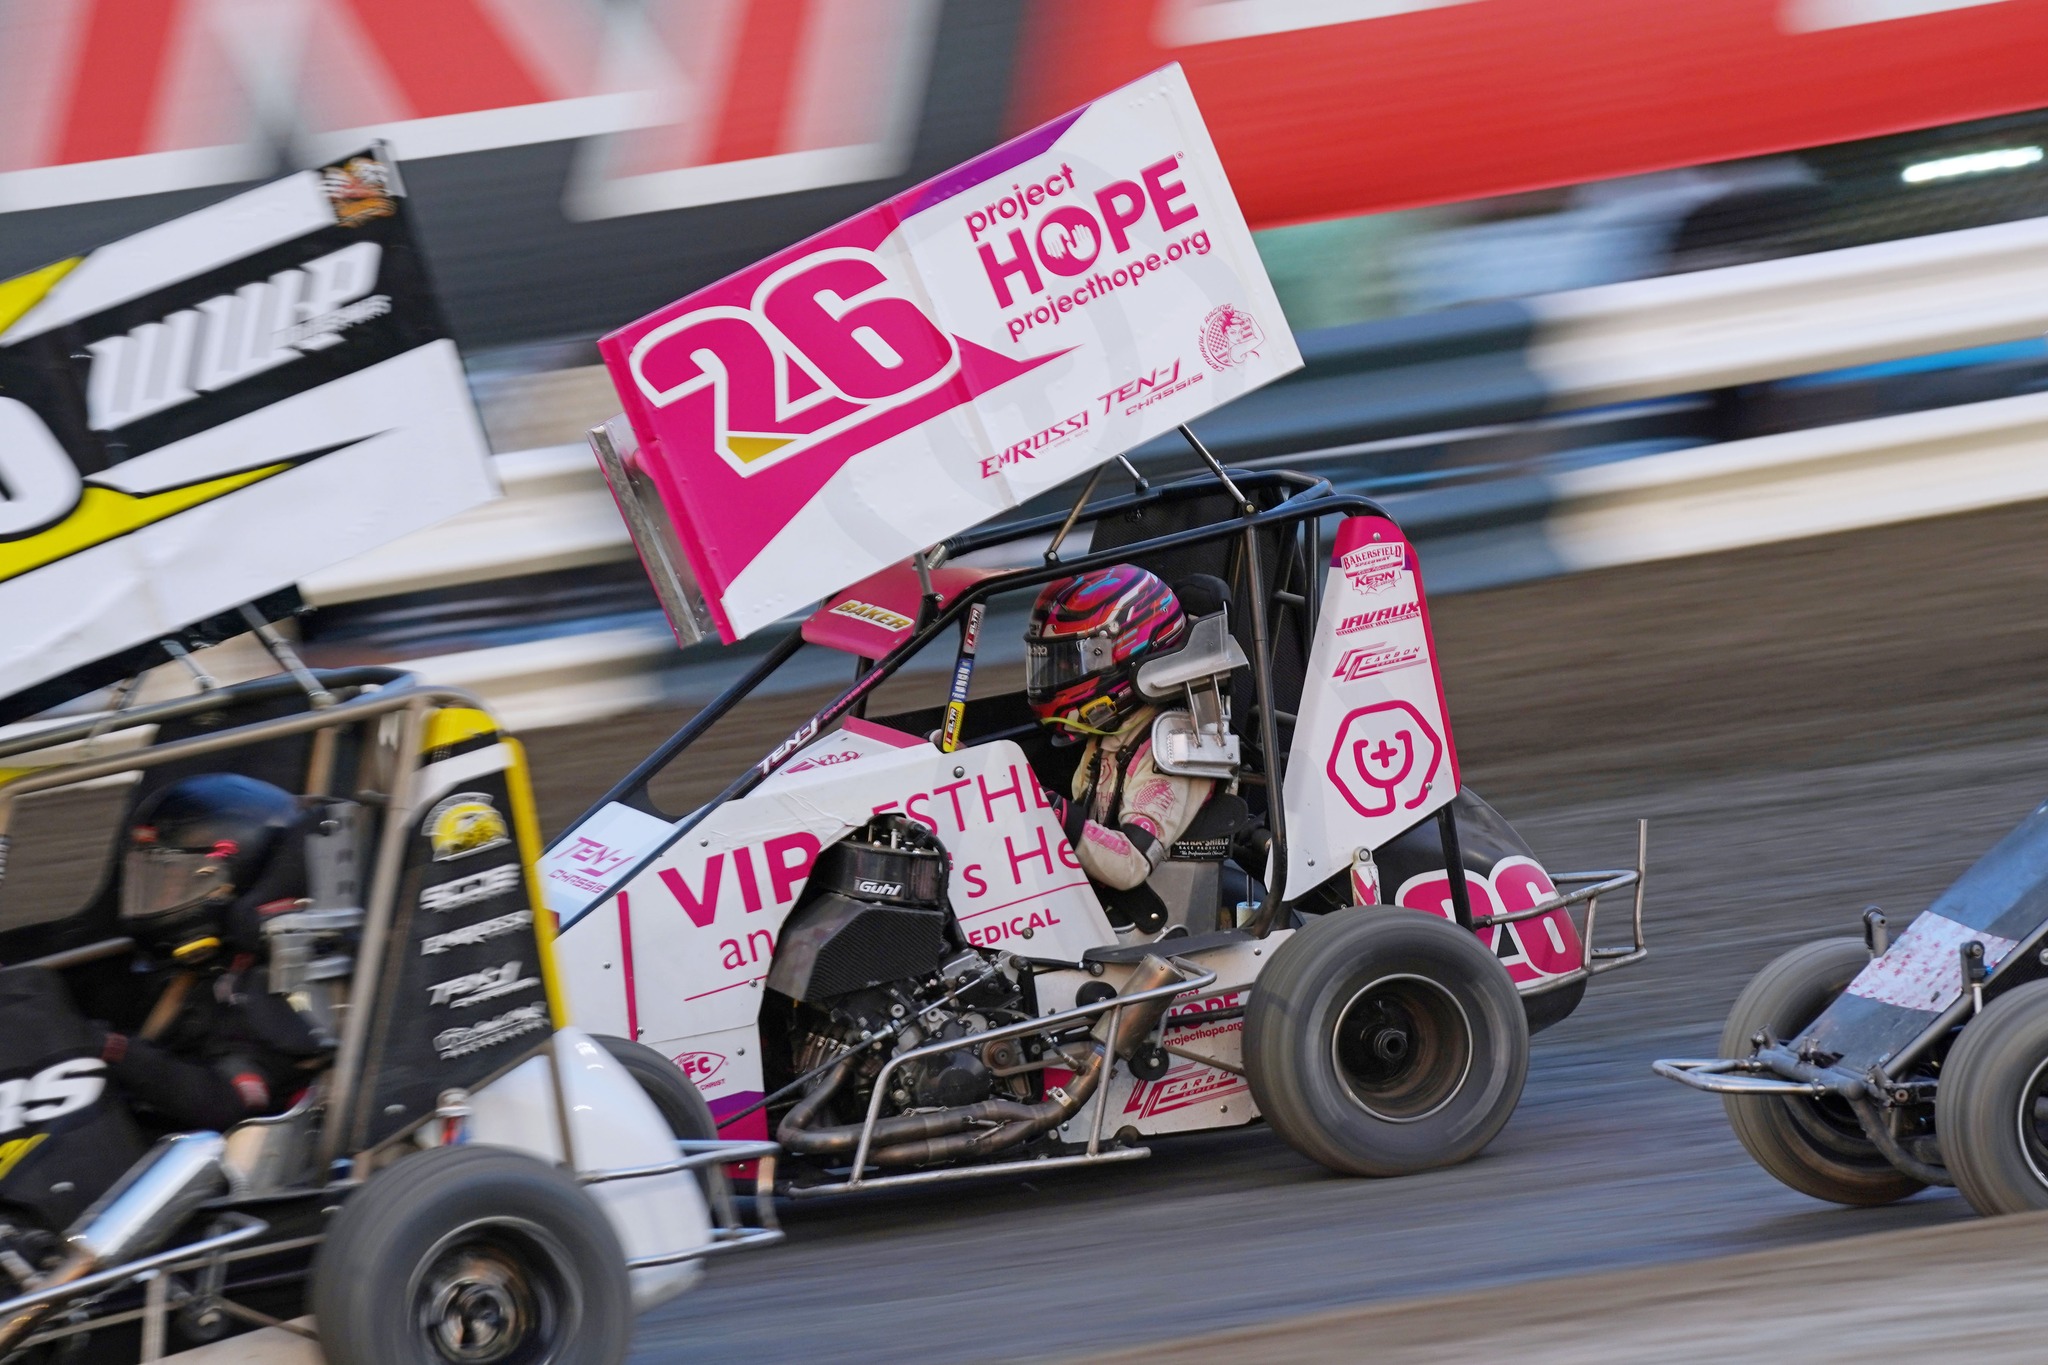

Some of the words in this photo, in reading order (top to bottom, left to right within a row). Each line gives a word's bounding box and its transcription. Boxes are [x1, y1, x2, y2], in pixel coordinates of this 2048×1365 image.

[964, 162, 1076, 242] project
[976, 153, 1199, 309] HOPE
[1005, 229, 1212, 343] projecthope.org
[629, 247, 961, 478] 26
[1125, 372, 1204, 416] CHASSIS
[1343, 545, 1402, 570] BAKERSFIELD
[1355, 570, 1396, 588] KERN
[832, 601, 914, 631] BAKER
[1364, 646, 1421, 665] CARBON
[548, 869, 608, 894] CHASSIS
[859, 880, 902, 897] Guhl
[968, 908, 1061, 947] EDICAL
[682, 1056, 711, 1079] FC
